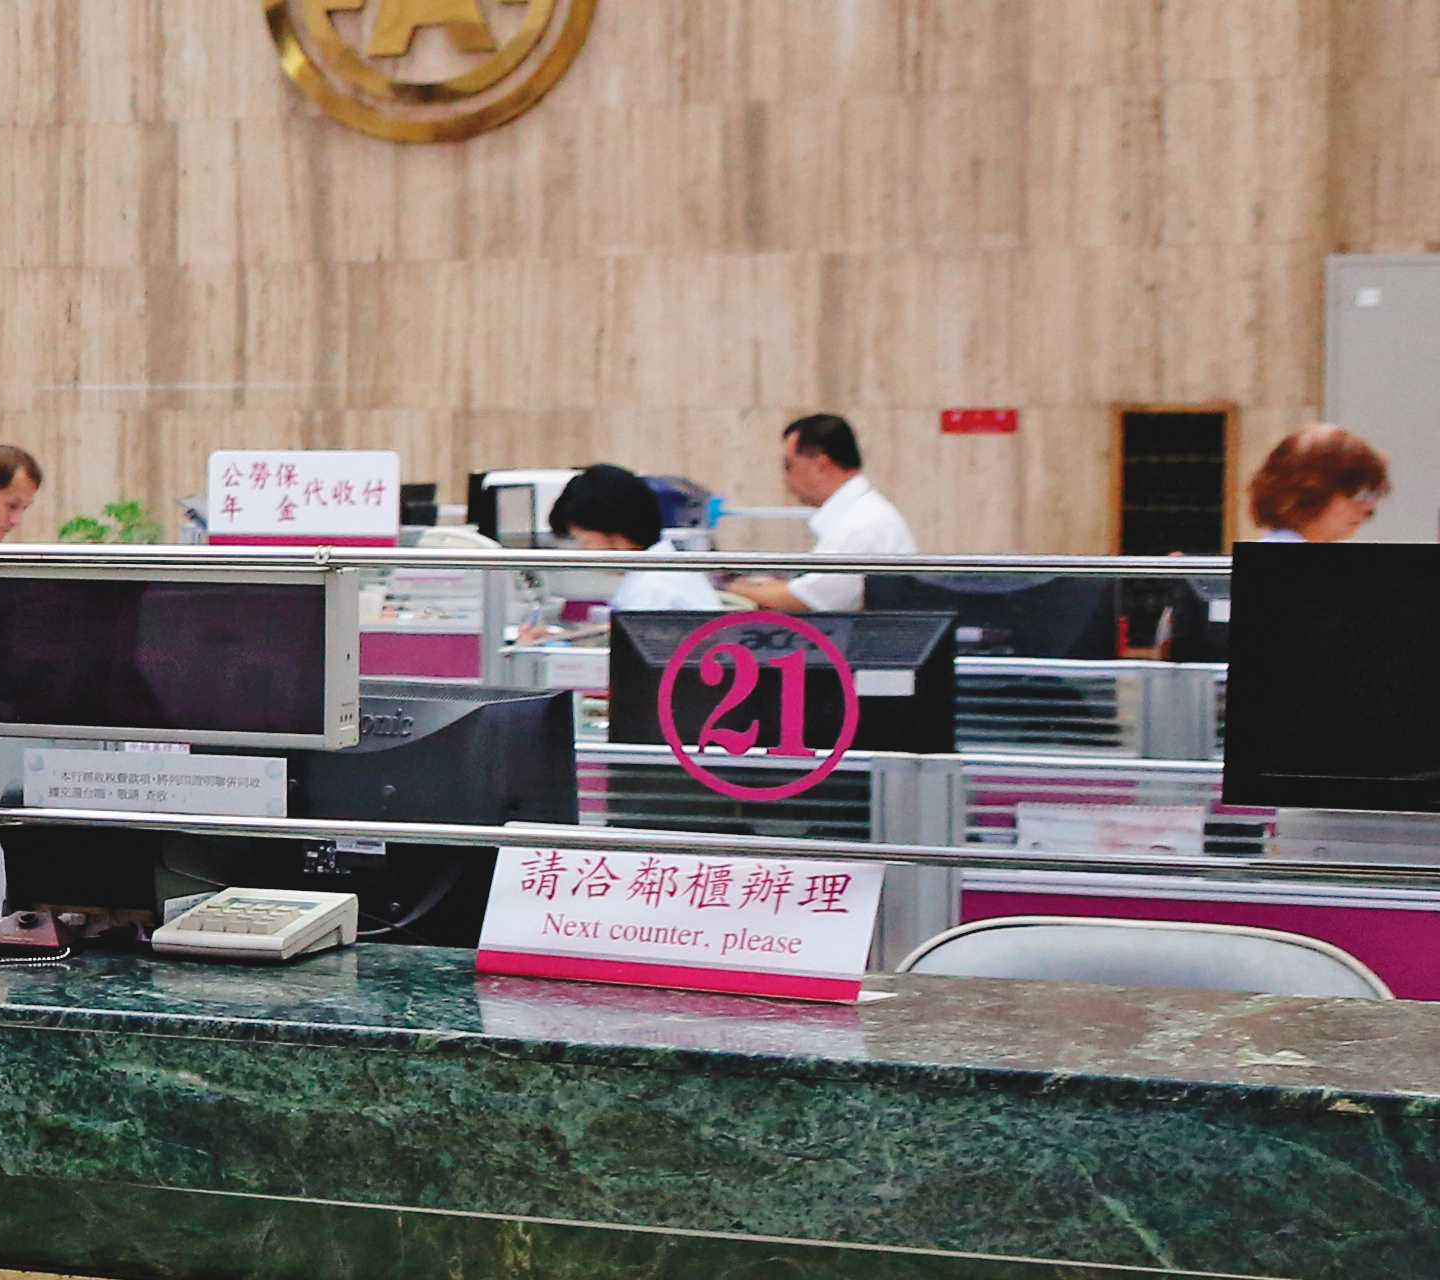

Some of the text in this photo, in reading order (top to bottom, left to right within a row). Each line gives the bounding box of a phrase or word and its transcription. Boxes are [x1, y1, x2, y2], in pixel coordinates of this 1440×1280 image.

[222, 461, 387, 506] 公勞保 代收付
[221, 494, 299, 522] 年金
[698, 643, 816, 757] 21
[519, 851, 853, 915] 請洽鄰櫃辦理
[541, 913, 802, 956] Next counter, please
